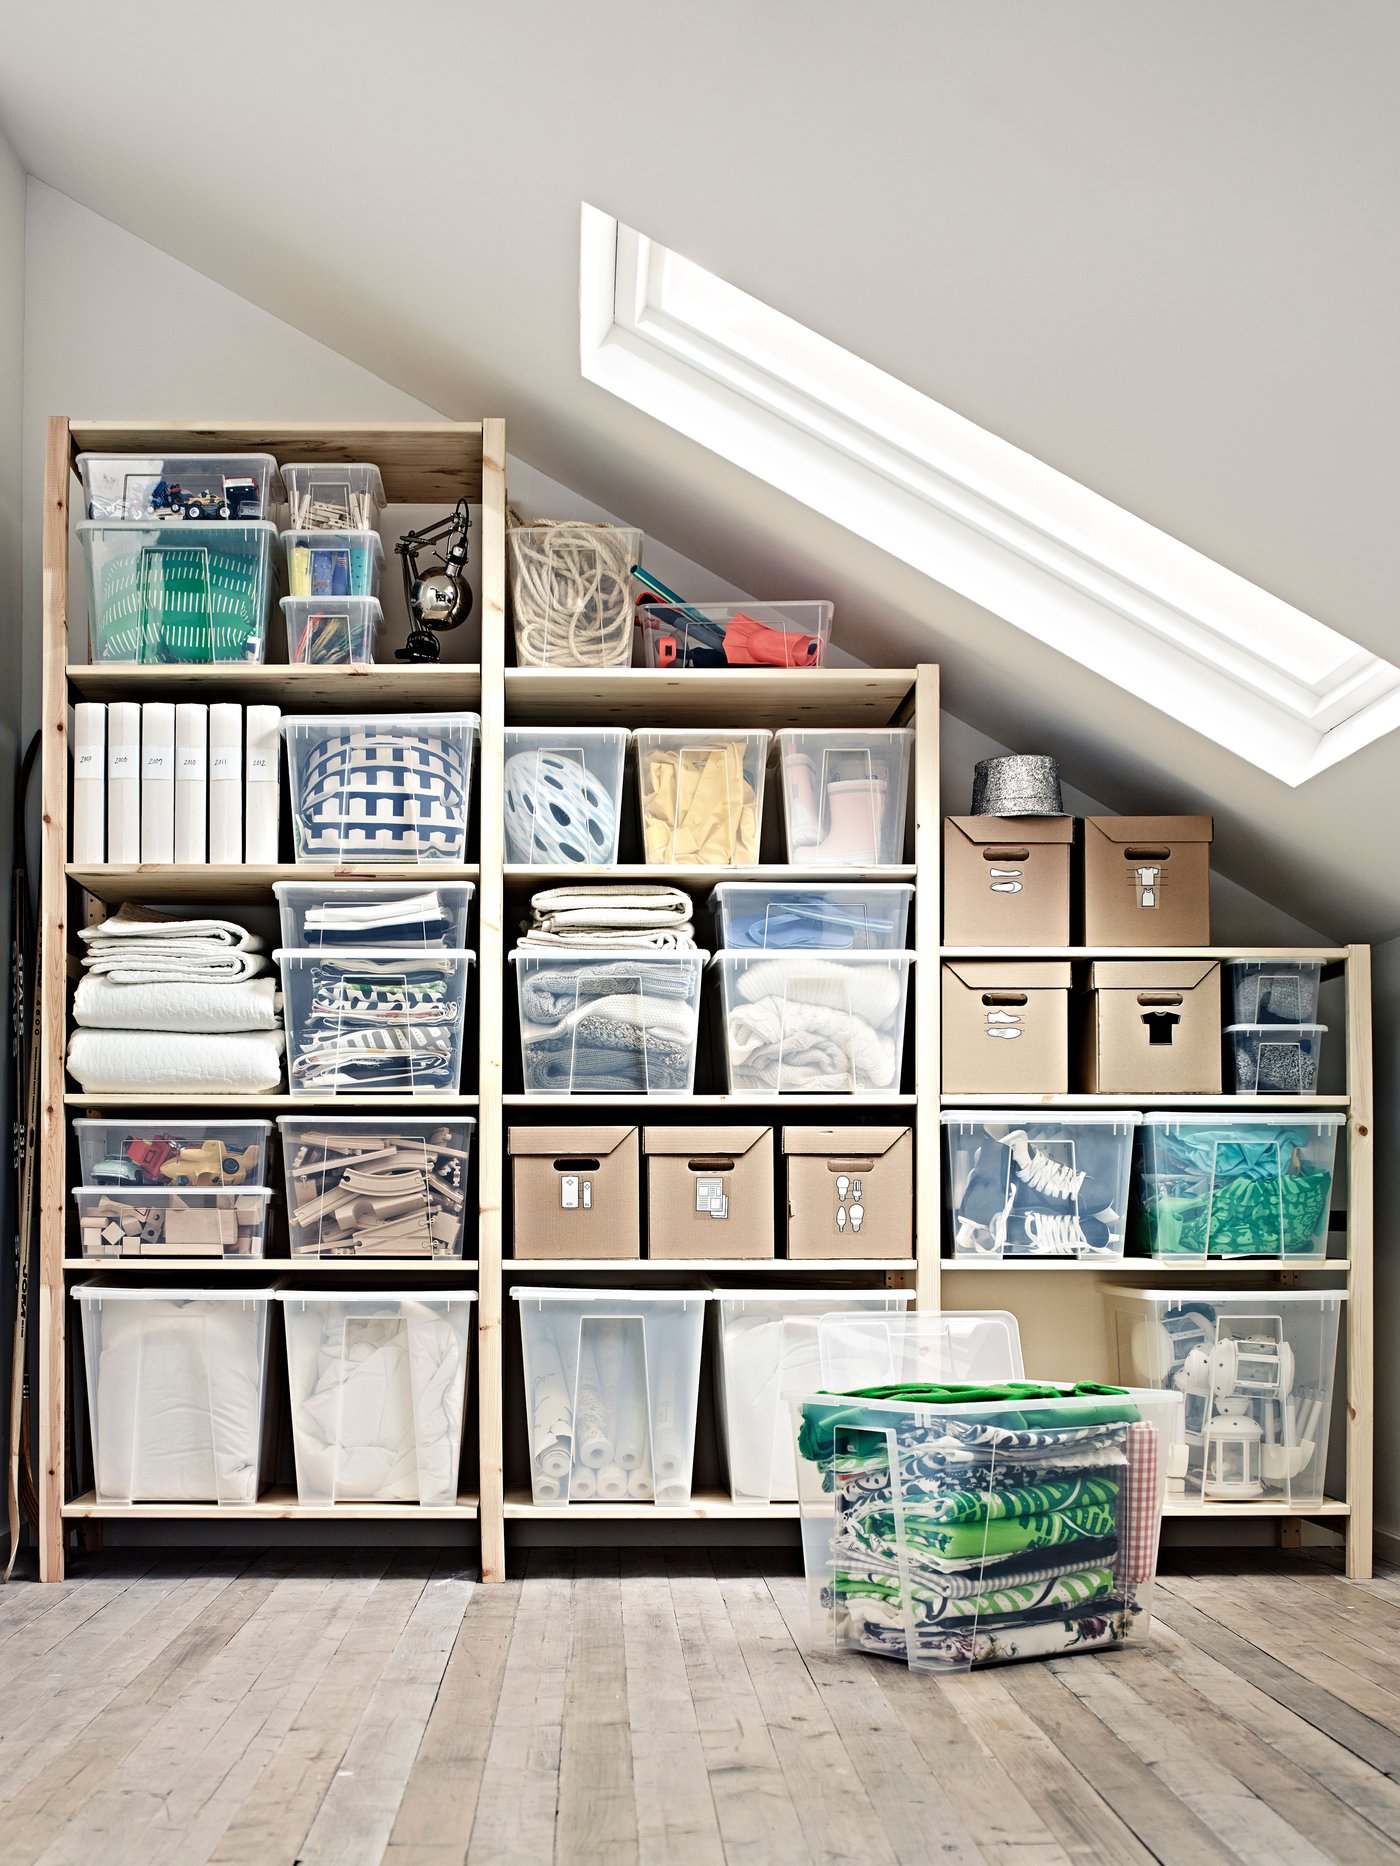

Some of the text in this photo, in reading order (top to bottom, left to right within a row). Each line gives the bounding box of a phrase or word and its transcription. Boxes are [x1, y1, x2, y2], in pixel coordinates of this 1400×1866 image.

[79, 755, 92, 763] 2007
[148, 758, 163, 766] 2009
[183, 758, 196, 766] 2010
[214, 758, 227, 766] 2011
[252, 759, 266, 767] 2012
